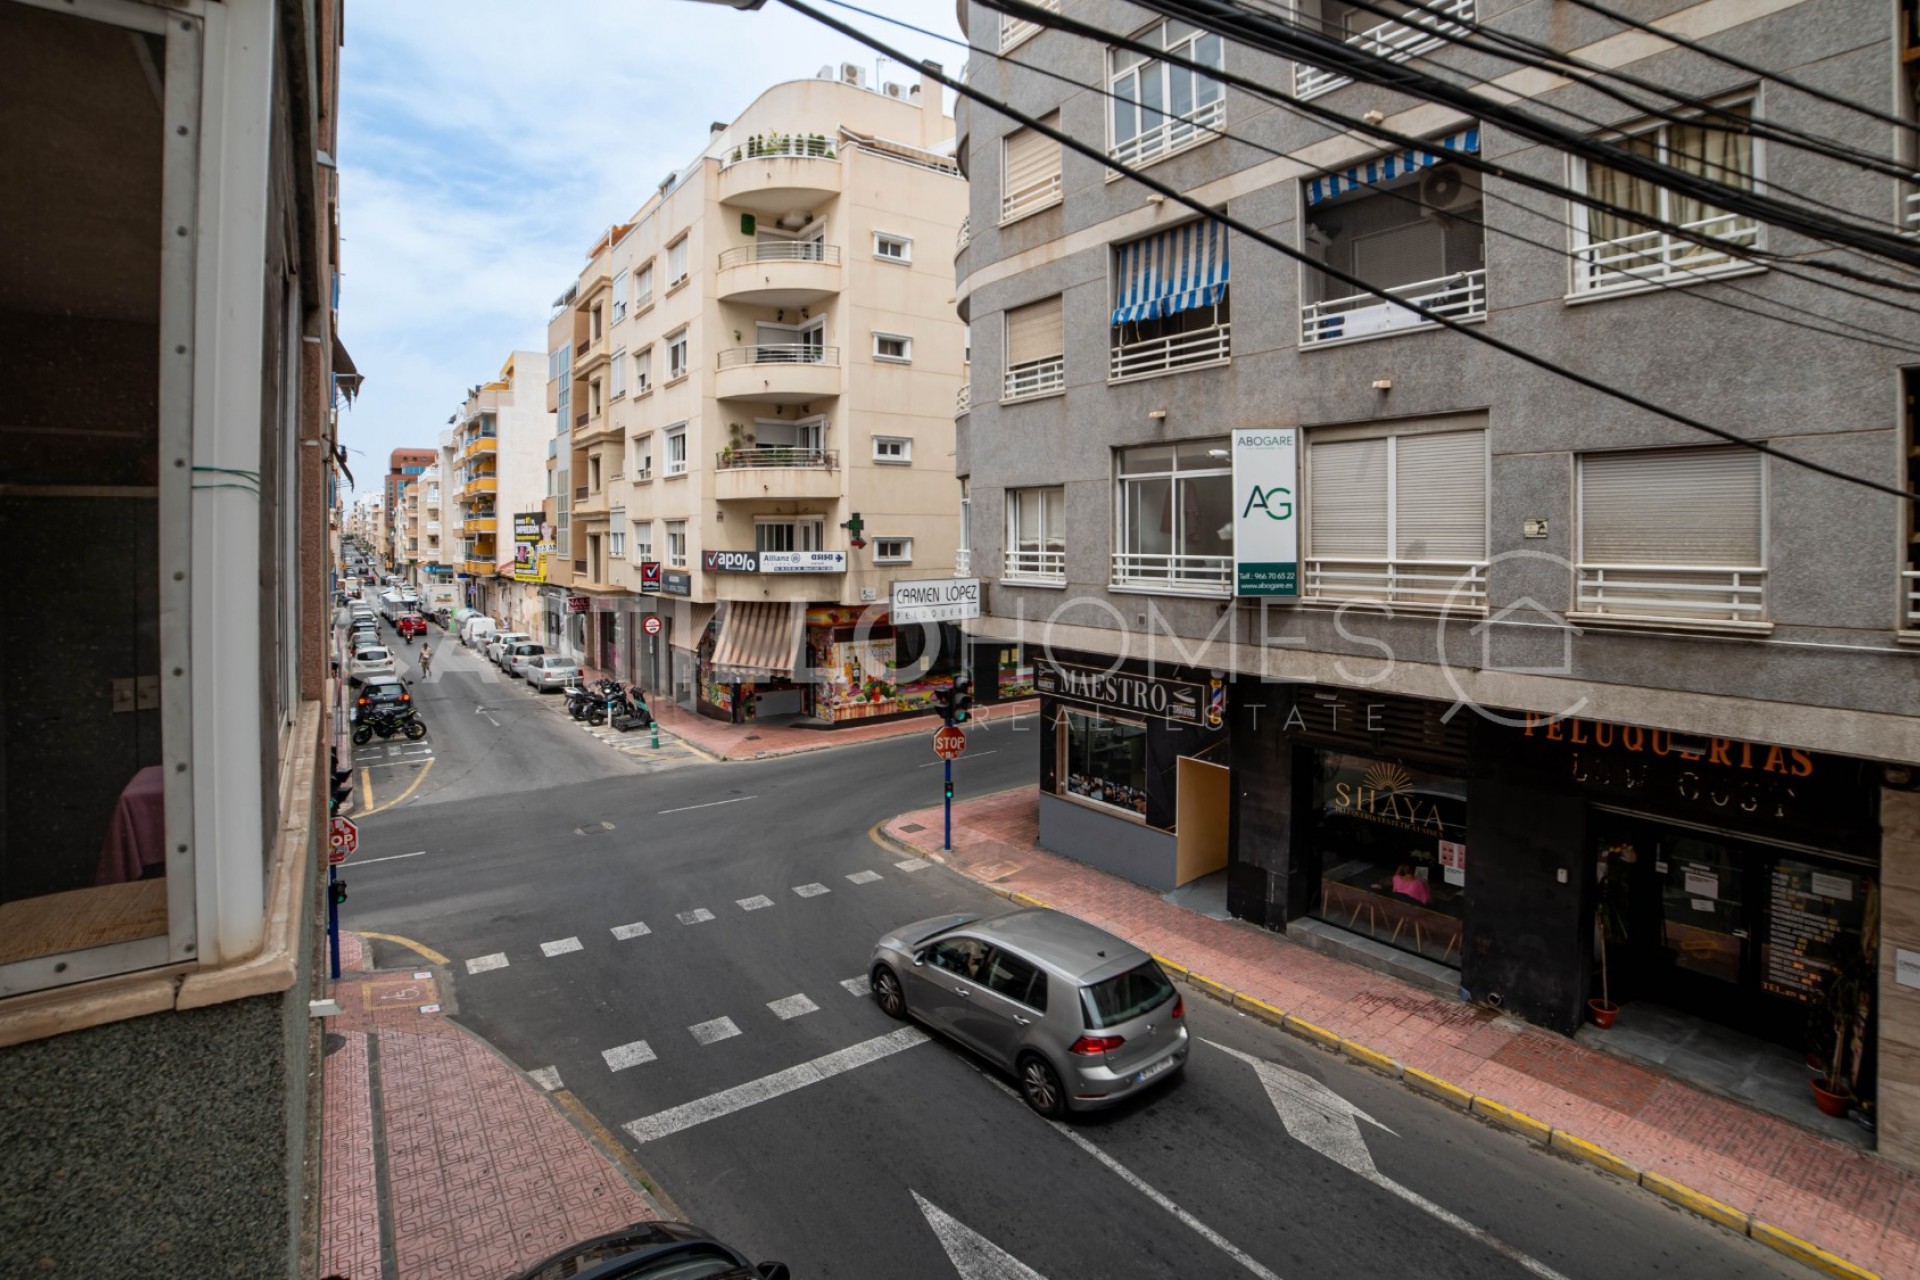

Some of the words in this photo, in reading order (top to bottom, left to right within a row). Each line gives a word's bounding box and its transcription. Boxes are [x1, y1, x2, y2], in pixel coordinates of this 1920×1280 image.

[1238, 436, 1293, 446] ABOGARE
[1242, 485, 1292, 520] AG
[718, 552, 756, 571] apolo
[764, 554, 790, 562] Allianz
[1254, 572, 1267, 580] 966
[1268, 572, 1277, 580] 70
[1286, 572, 1295, 580] 22
[896, 586, 940, 604] CARMEN
[945, 580, 977, 602] LÓPEZ
[1241, 582, 1294, 591] www.abogare.es
[1060, 668, 1168, 712] MAESTRO
[936, 736, 965, 750] STOP
[1335, 782, 1444, 832] SHAYA
